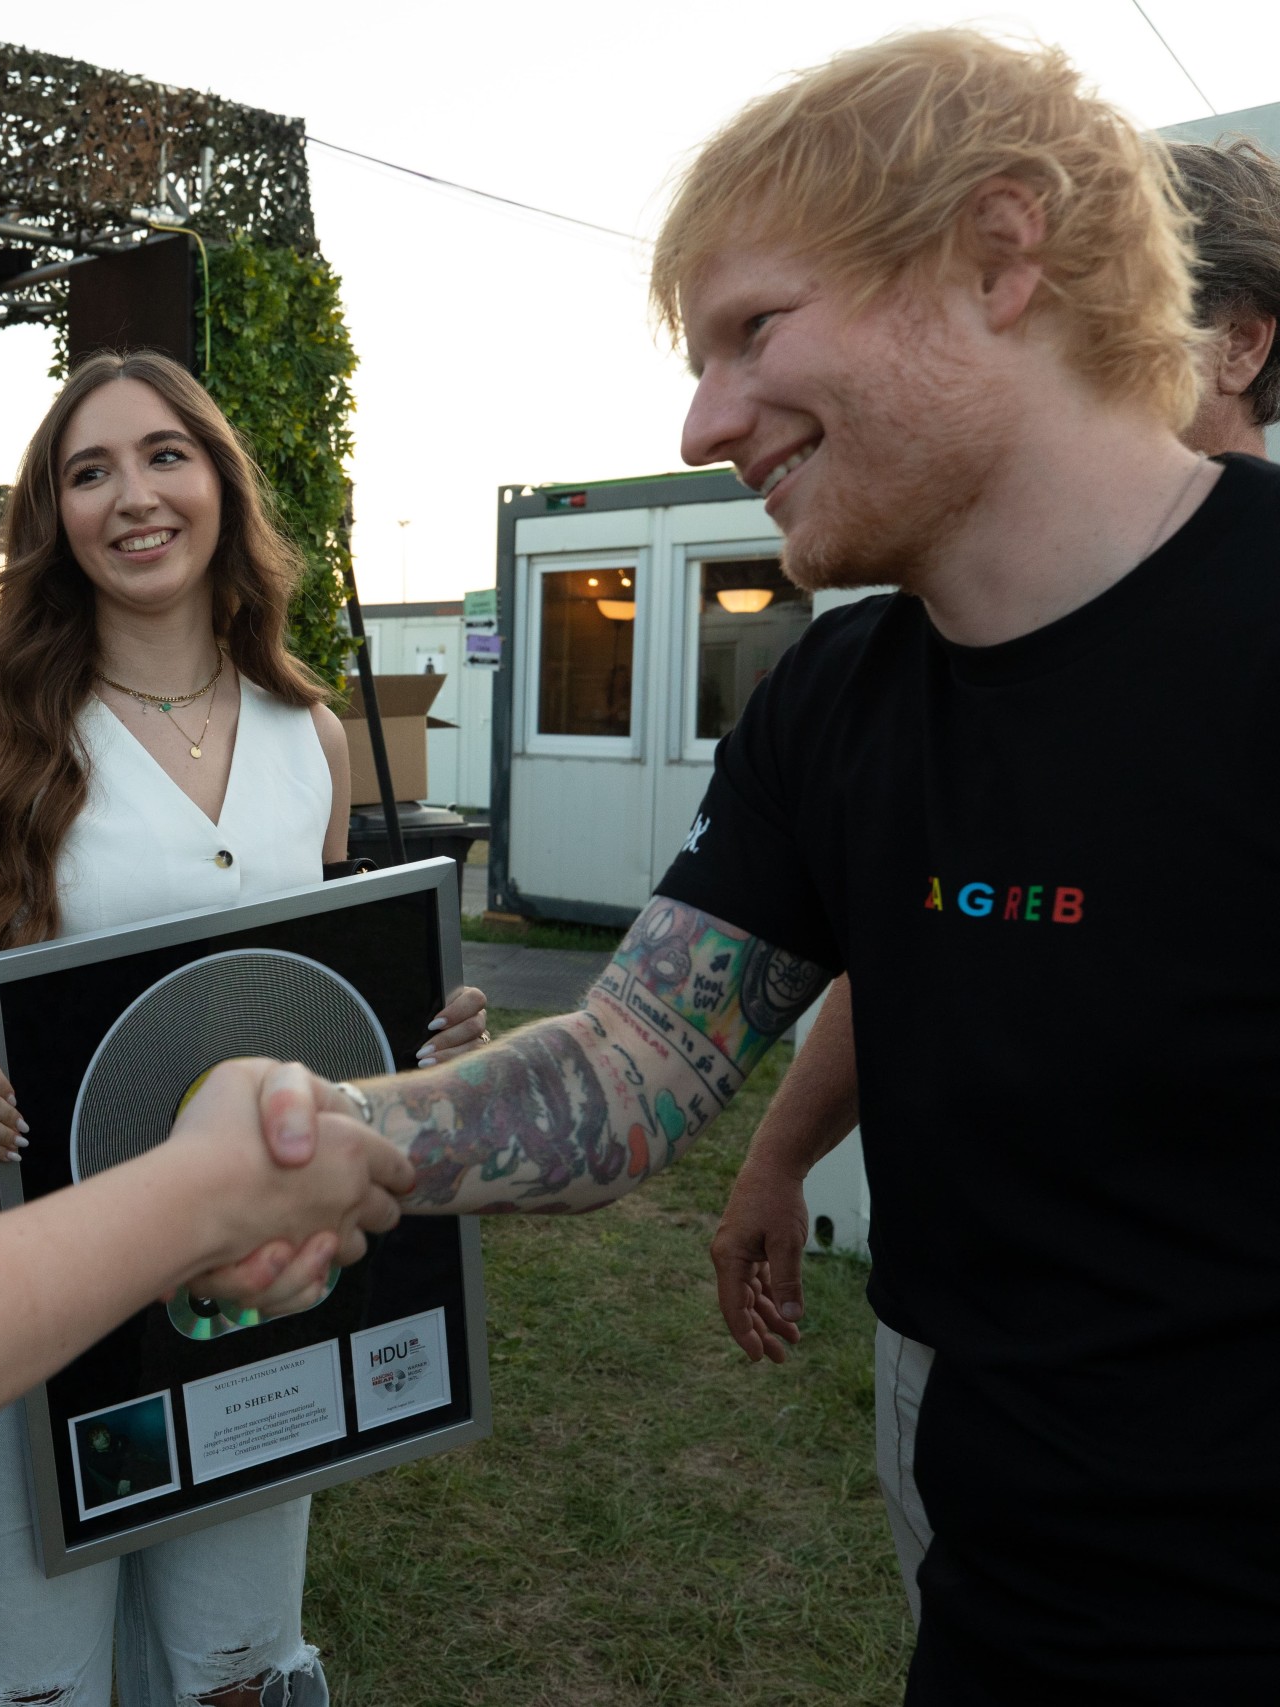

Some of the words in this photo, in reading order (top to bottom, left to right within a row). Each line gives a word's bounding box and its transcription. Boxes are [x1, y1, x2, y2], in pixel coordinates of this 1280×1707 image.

[694, 973, 724, 997] KOOL
[370, 1341, 408, 1367] HDU
[214, 1367, 278, 1392] MULTI-PLATINUM
[279, 1359, 305, 1372] AWARD
[225, 1403, 241, 1415] ED
[244, 1385, 300, 1408] SHEERAN
[203, 1430, 255, 1450] singer-songwriter
[263, 1418, 289, 1431] Croatian
[289, 1412, 305, 1424] radio
[305, 1407, 327, 1421] airplay
[213, 1430, 223, 1439] for
[223, 1426, 234, 1434] the
[234, 1422, 248, 1432] most
[249, 1412, 277, 1427] successful
[277, 1401, 315, 1419] international
[238, 1437, 251, 1448] and
[251, 1427, 284, 1445] exceptional
[284, 1420, 310, 1435] influence
[319, 1414, 329, 1423] the
[234, 1444, 261, 1456] Croatian
[261, 1438, 279, 1449] music
[279, 1431, 300, 1444] market
